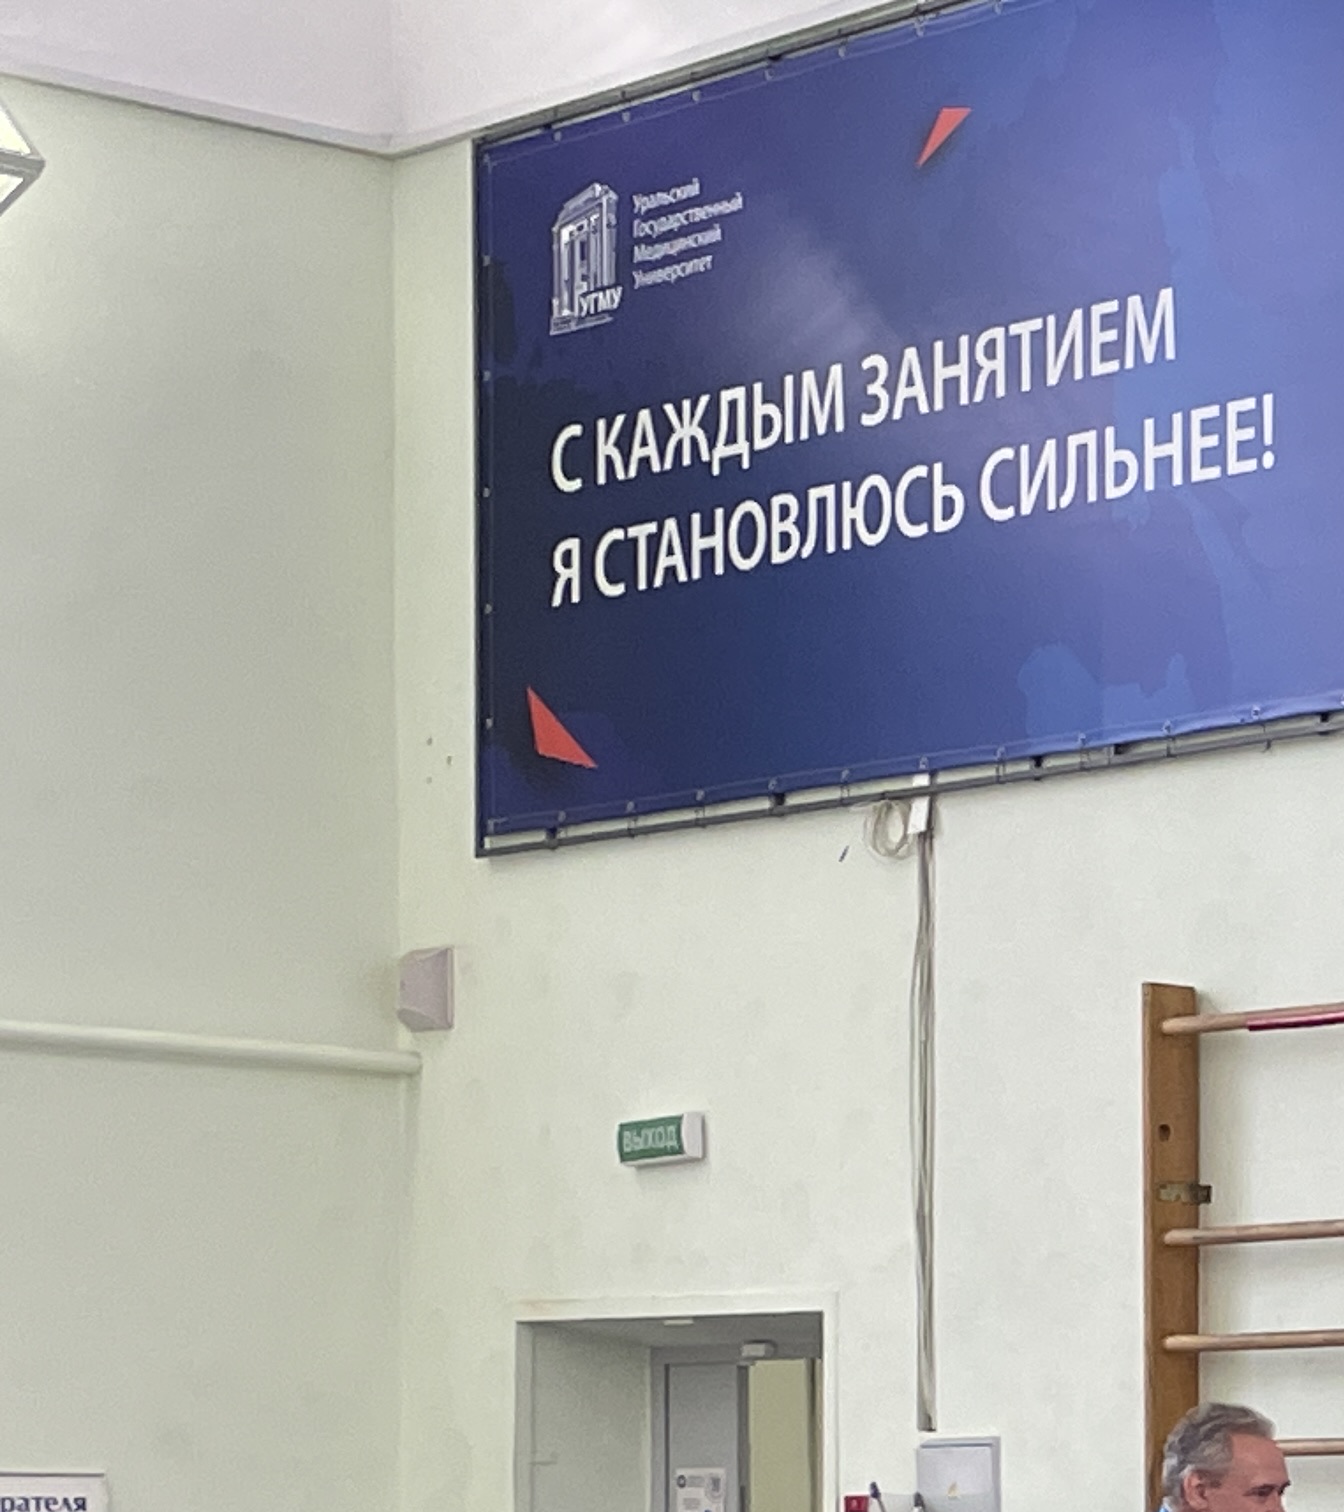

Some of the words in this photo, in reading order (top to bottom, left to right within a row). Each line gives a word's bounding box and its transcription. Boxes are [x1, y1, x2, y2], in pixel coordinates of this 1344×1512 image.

[632, 177, 700, 215] Уральский
[632, 191, 743, 239] Государственный
[633, 223, 722, 263] Медицинский
[632, 255, 713, 289] Университет
[579, 286, 623, 317] УГМУ
[551, 423, 583, 492] С
[597, 363, 845, 476] КАЖДЫМ
[860, 287, 1176, 426] ЗАНЯТИЕМ
[551, 537, 581, 608] Я
[594, 461, 966, 597] СТАНОВЛЮСЬ
[980, 393, 1276, 522] СИЛЬНЕЕ!
[623, 1124, 680, 1153] ВЫХОД
